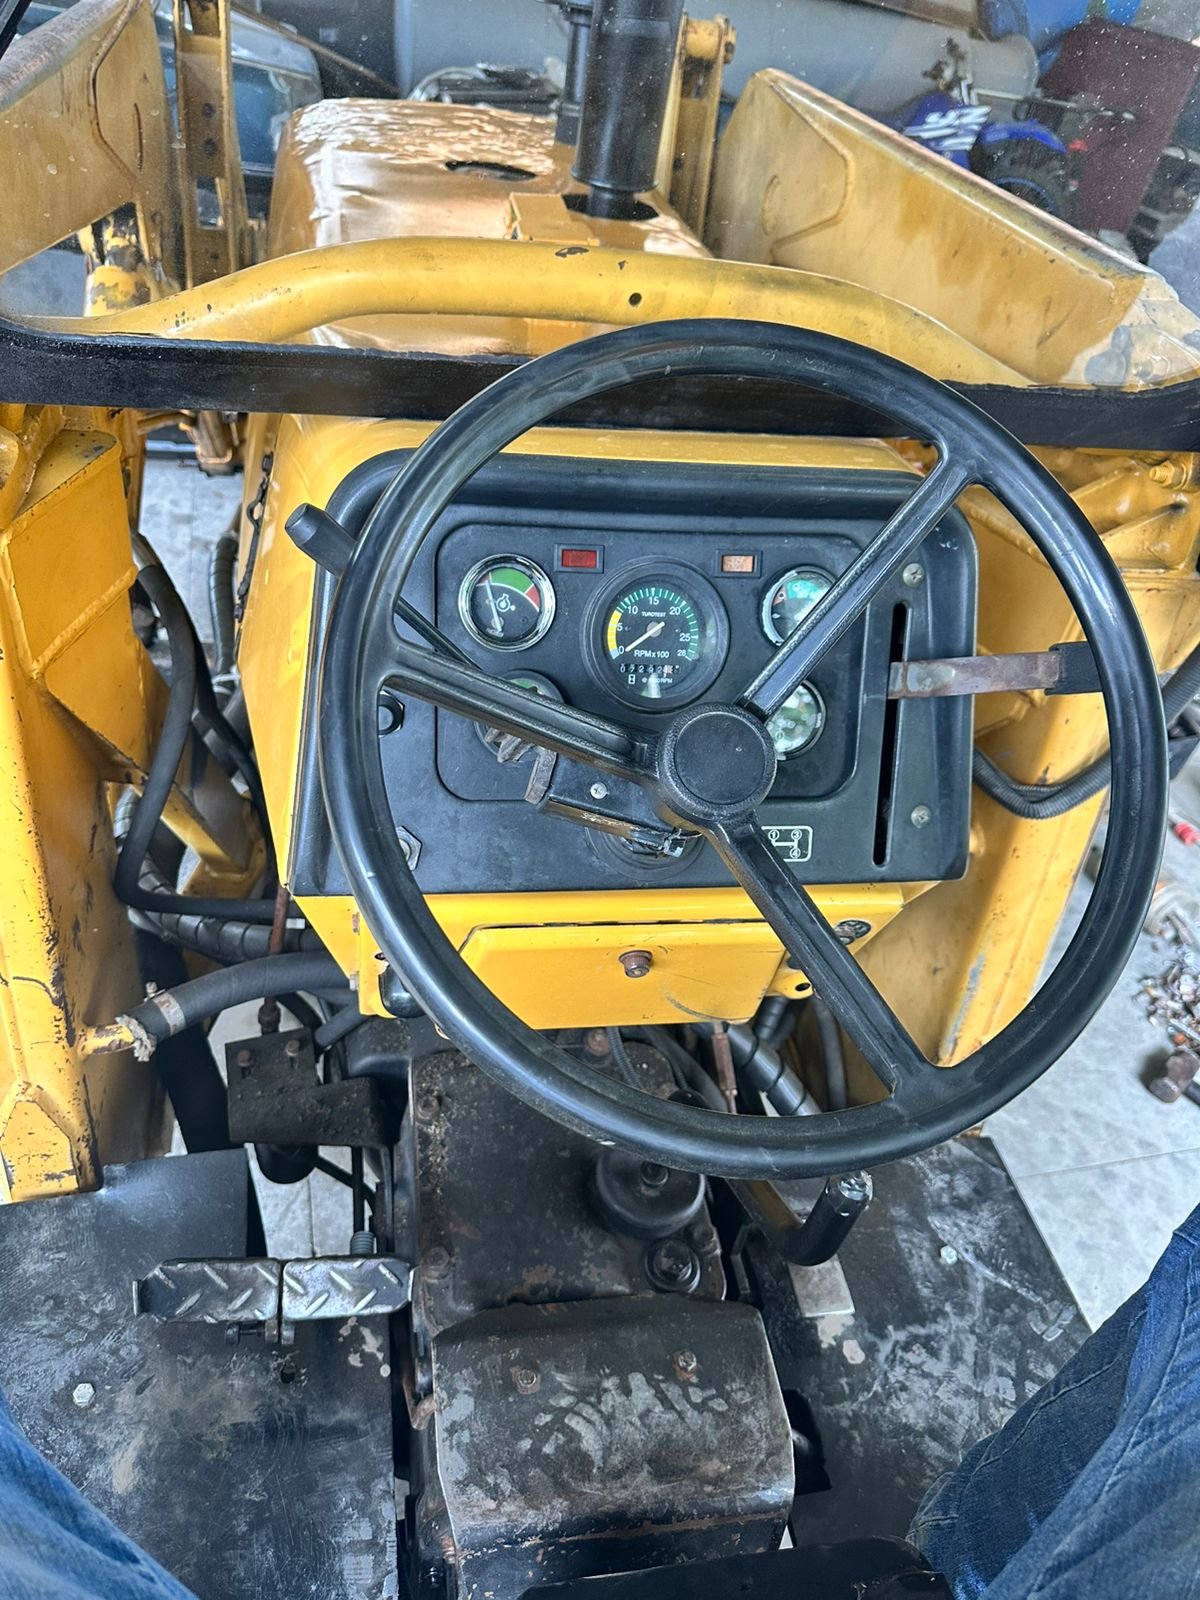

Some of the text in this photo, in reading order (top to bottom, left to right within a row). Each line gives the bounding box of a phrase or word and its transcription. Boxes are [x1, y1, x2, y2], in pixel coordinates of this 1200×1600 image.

[649, 597, 659, 605] 15
[628, 605, 638, 614] 10
[669, 606, 681, 615] 20
[617, 623, 623, 631] 5
[680, 633, 690, 641] 25
[619, 646, 624, 654] 0
